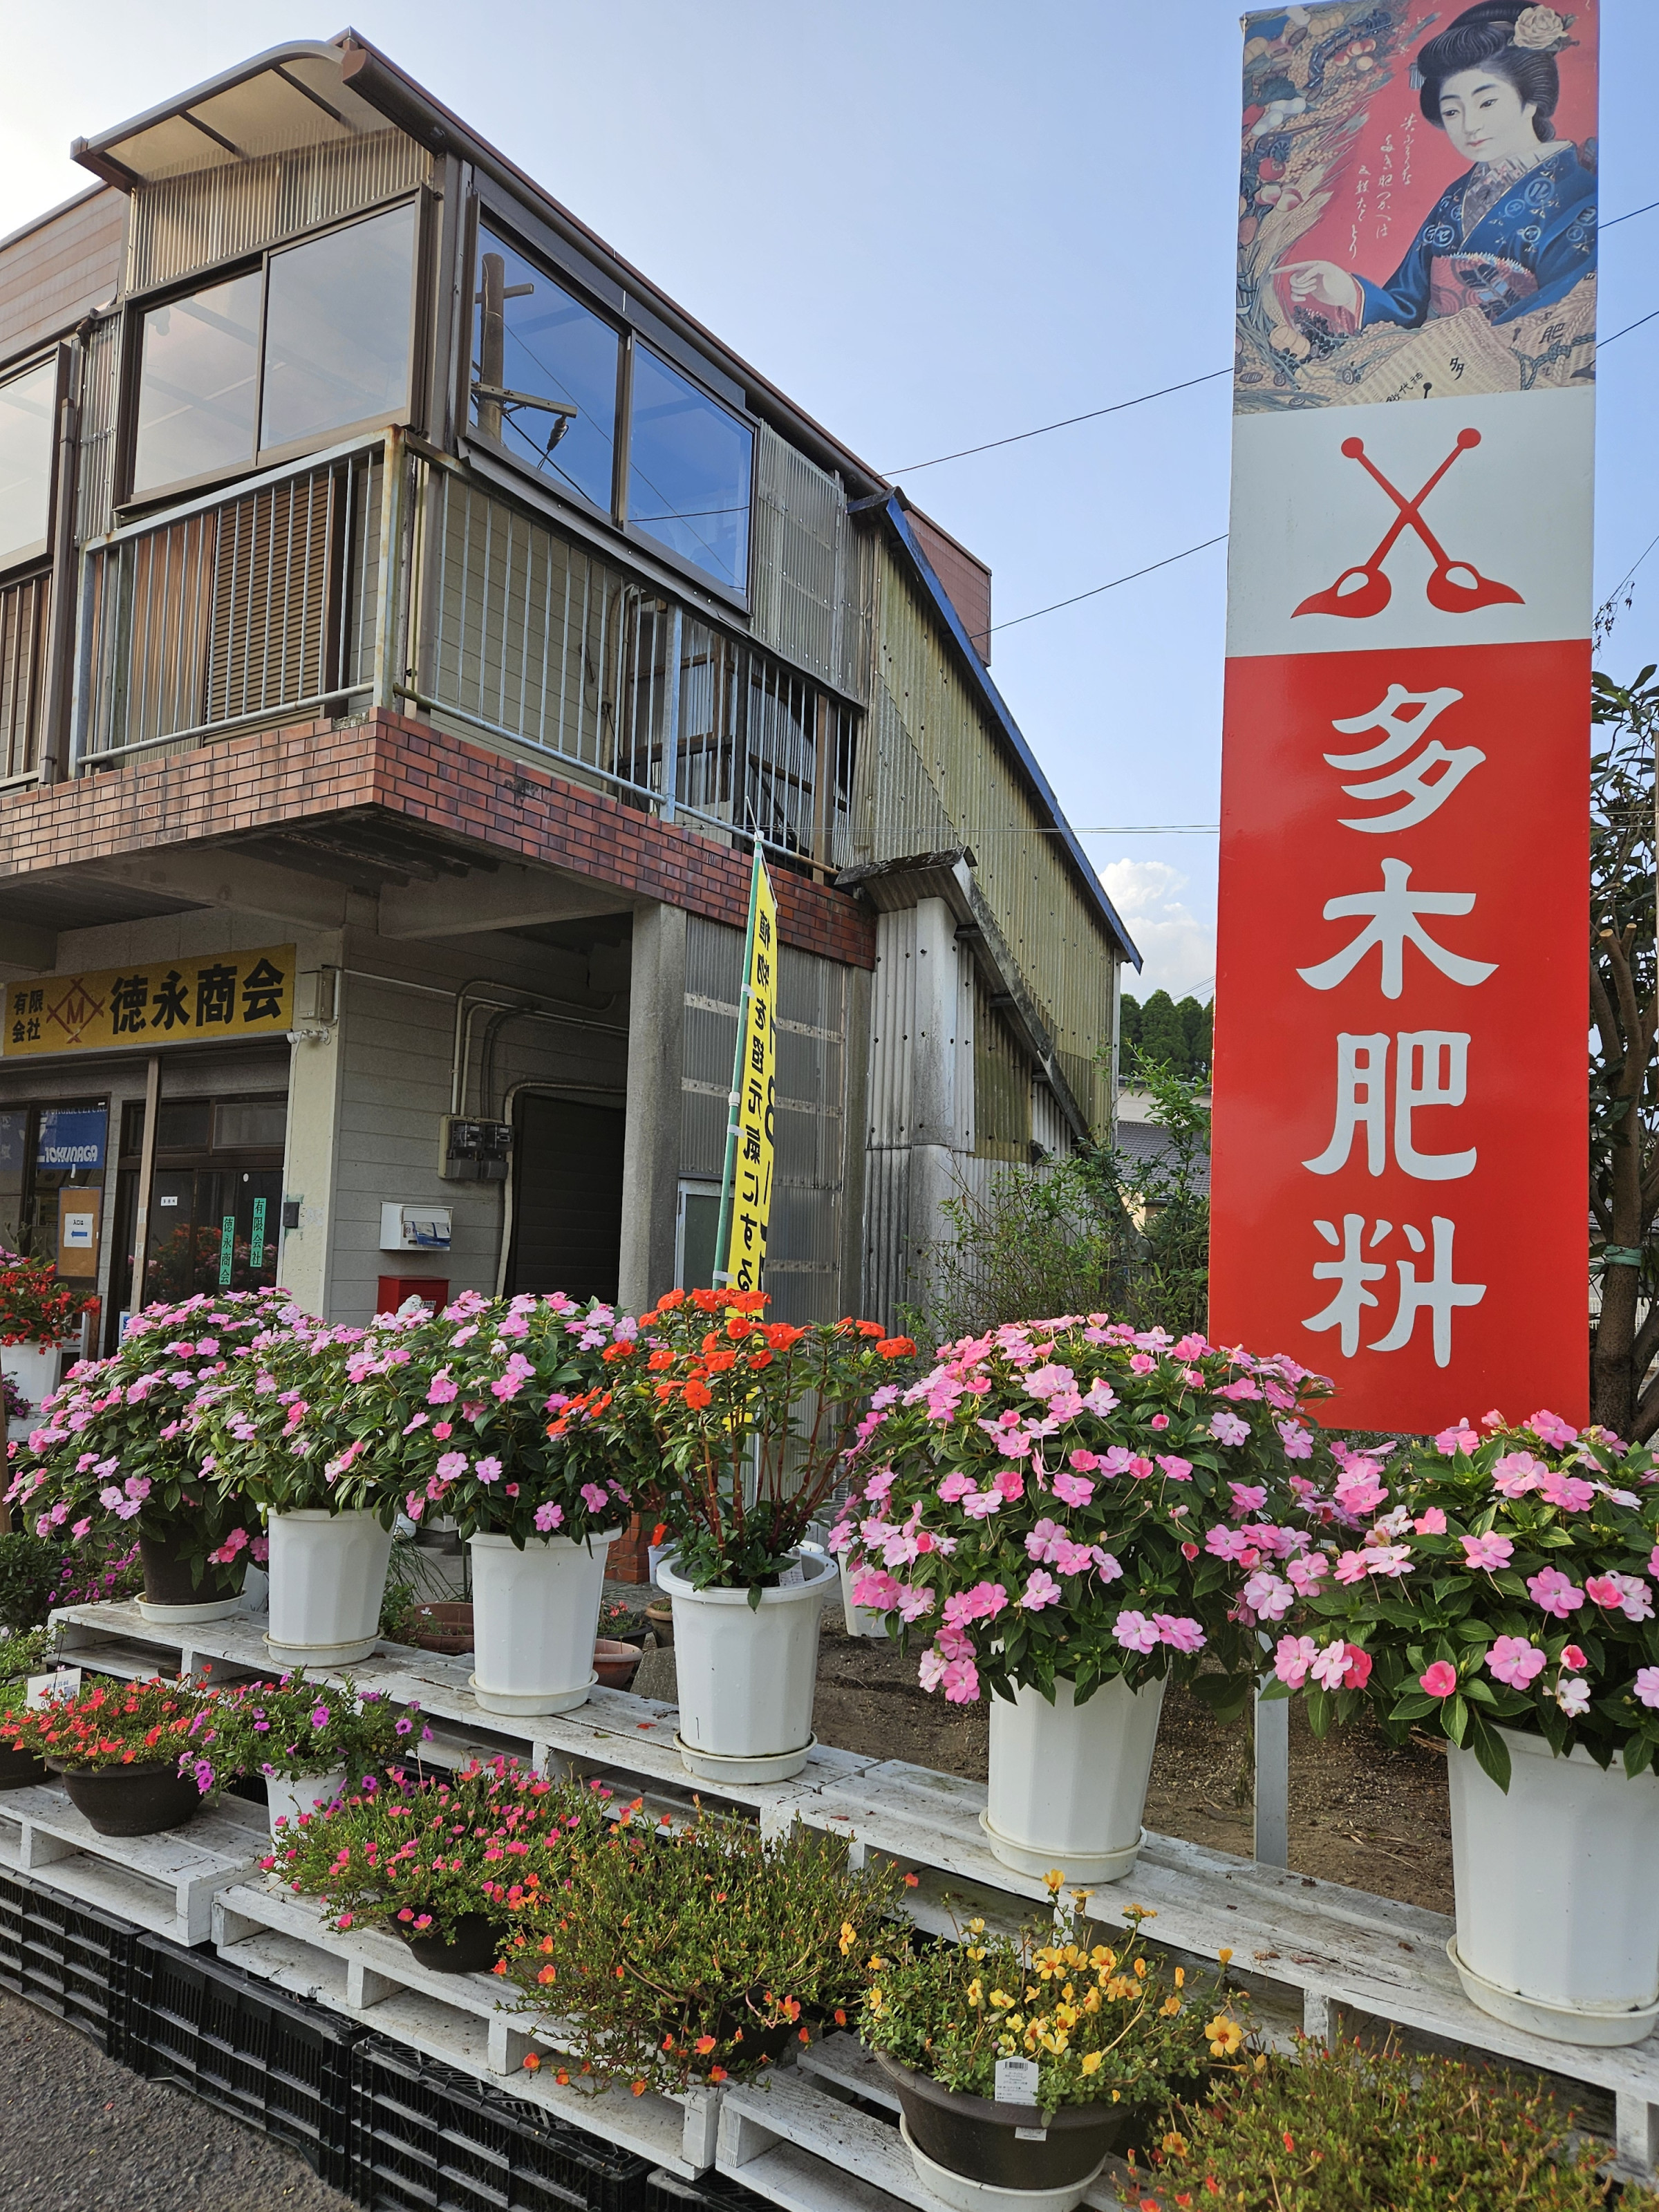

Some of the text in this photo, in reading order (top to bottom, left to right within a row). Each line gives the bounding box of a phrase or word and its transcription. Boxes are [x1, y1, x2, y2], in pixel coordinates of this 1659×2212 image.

[1538, 322, 1566, 344] 肥
[14, 988, 44, 1015] 有限
[66, 996, 84, 1024] M
[109, 957, 285, 1035] 徳永商会
[12, 1017, 41, 1044] 会社
[1296, 683, 1499, 1368] 多木肥料
[221, 1217, 234, 1284] 徳永商会
[252, 1199, 265, 1266] 有限会社
